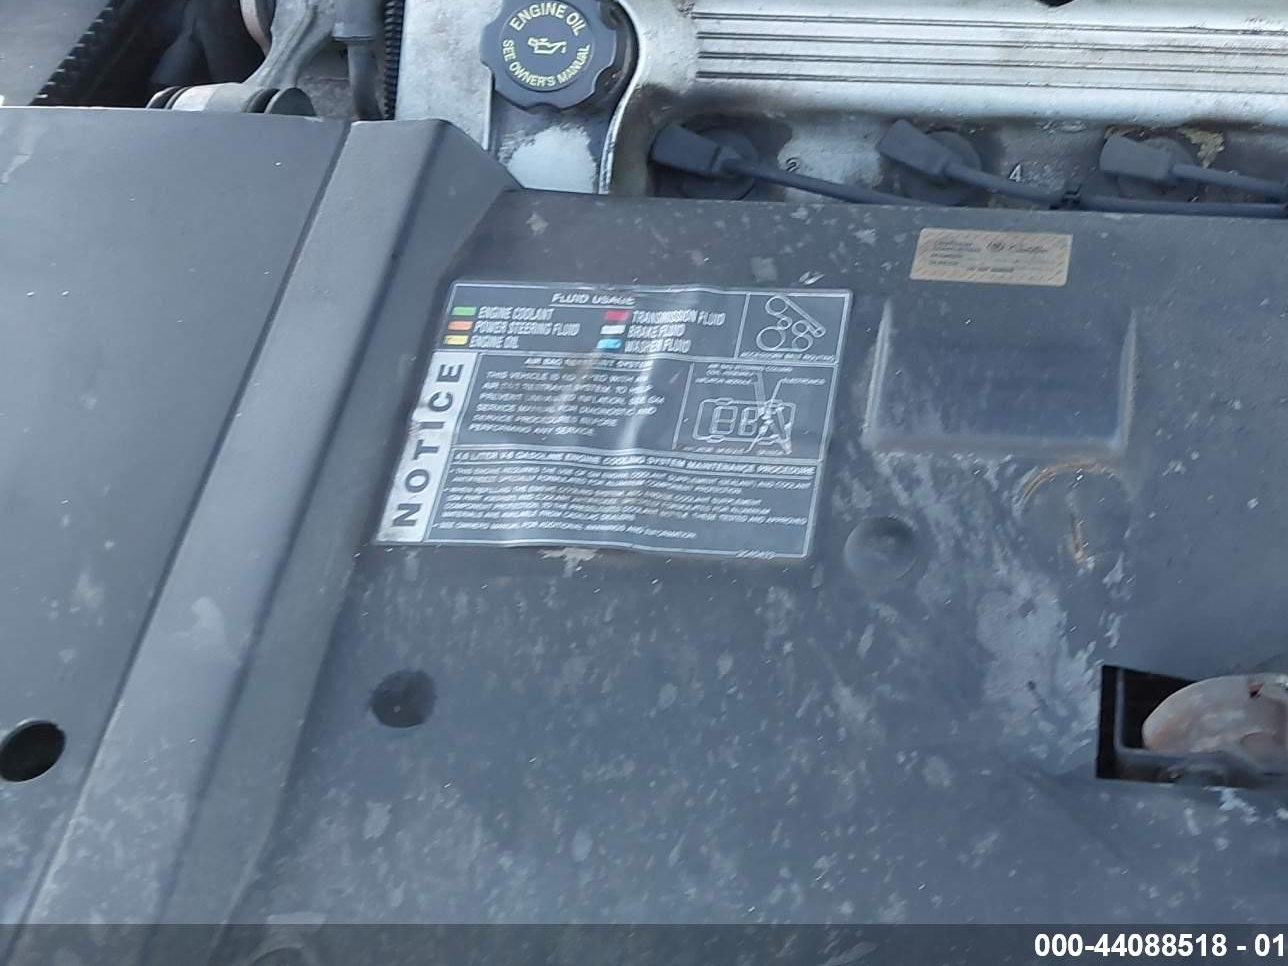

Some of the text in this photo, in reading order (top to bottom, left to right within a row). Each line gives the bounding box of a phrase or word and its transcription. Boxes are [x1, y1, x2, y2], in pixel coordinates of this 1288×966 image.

[509, 1, 587, 37] ENGINE OIL
[502, 39, 591, 87] SEE OWNER'S MANUAL
[1008, 162, 1022, 183] 4
[551, 293, 636, 305] FLUID USAGE
[477, 306, 555, 321] ENGINE COOLANT
[697, 312, 727, 326] FLUID
[473, 321, 581, 337] POWER STEERING FLUID
[628, 323, 686, 338] BRAKE FLUID
[469, 335, 519, 349] ENGINE OIL
[662, 339, 692, 352] FLUID
[392, 363, 464, 527] NOTICE
